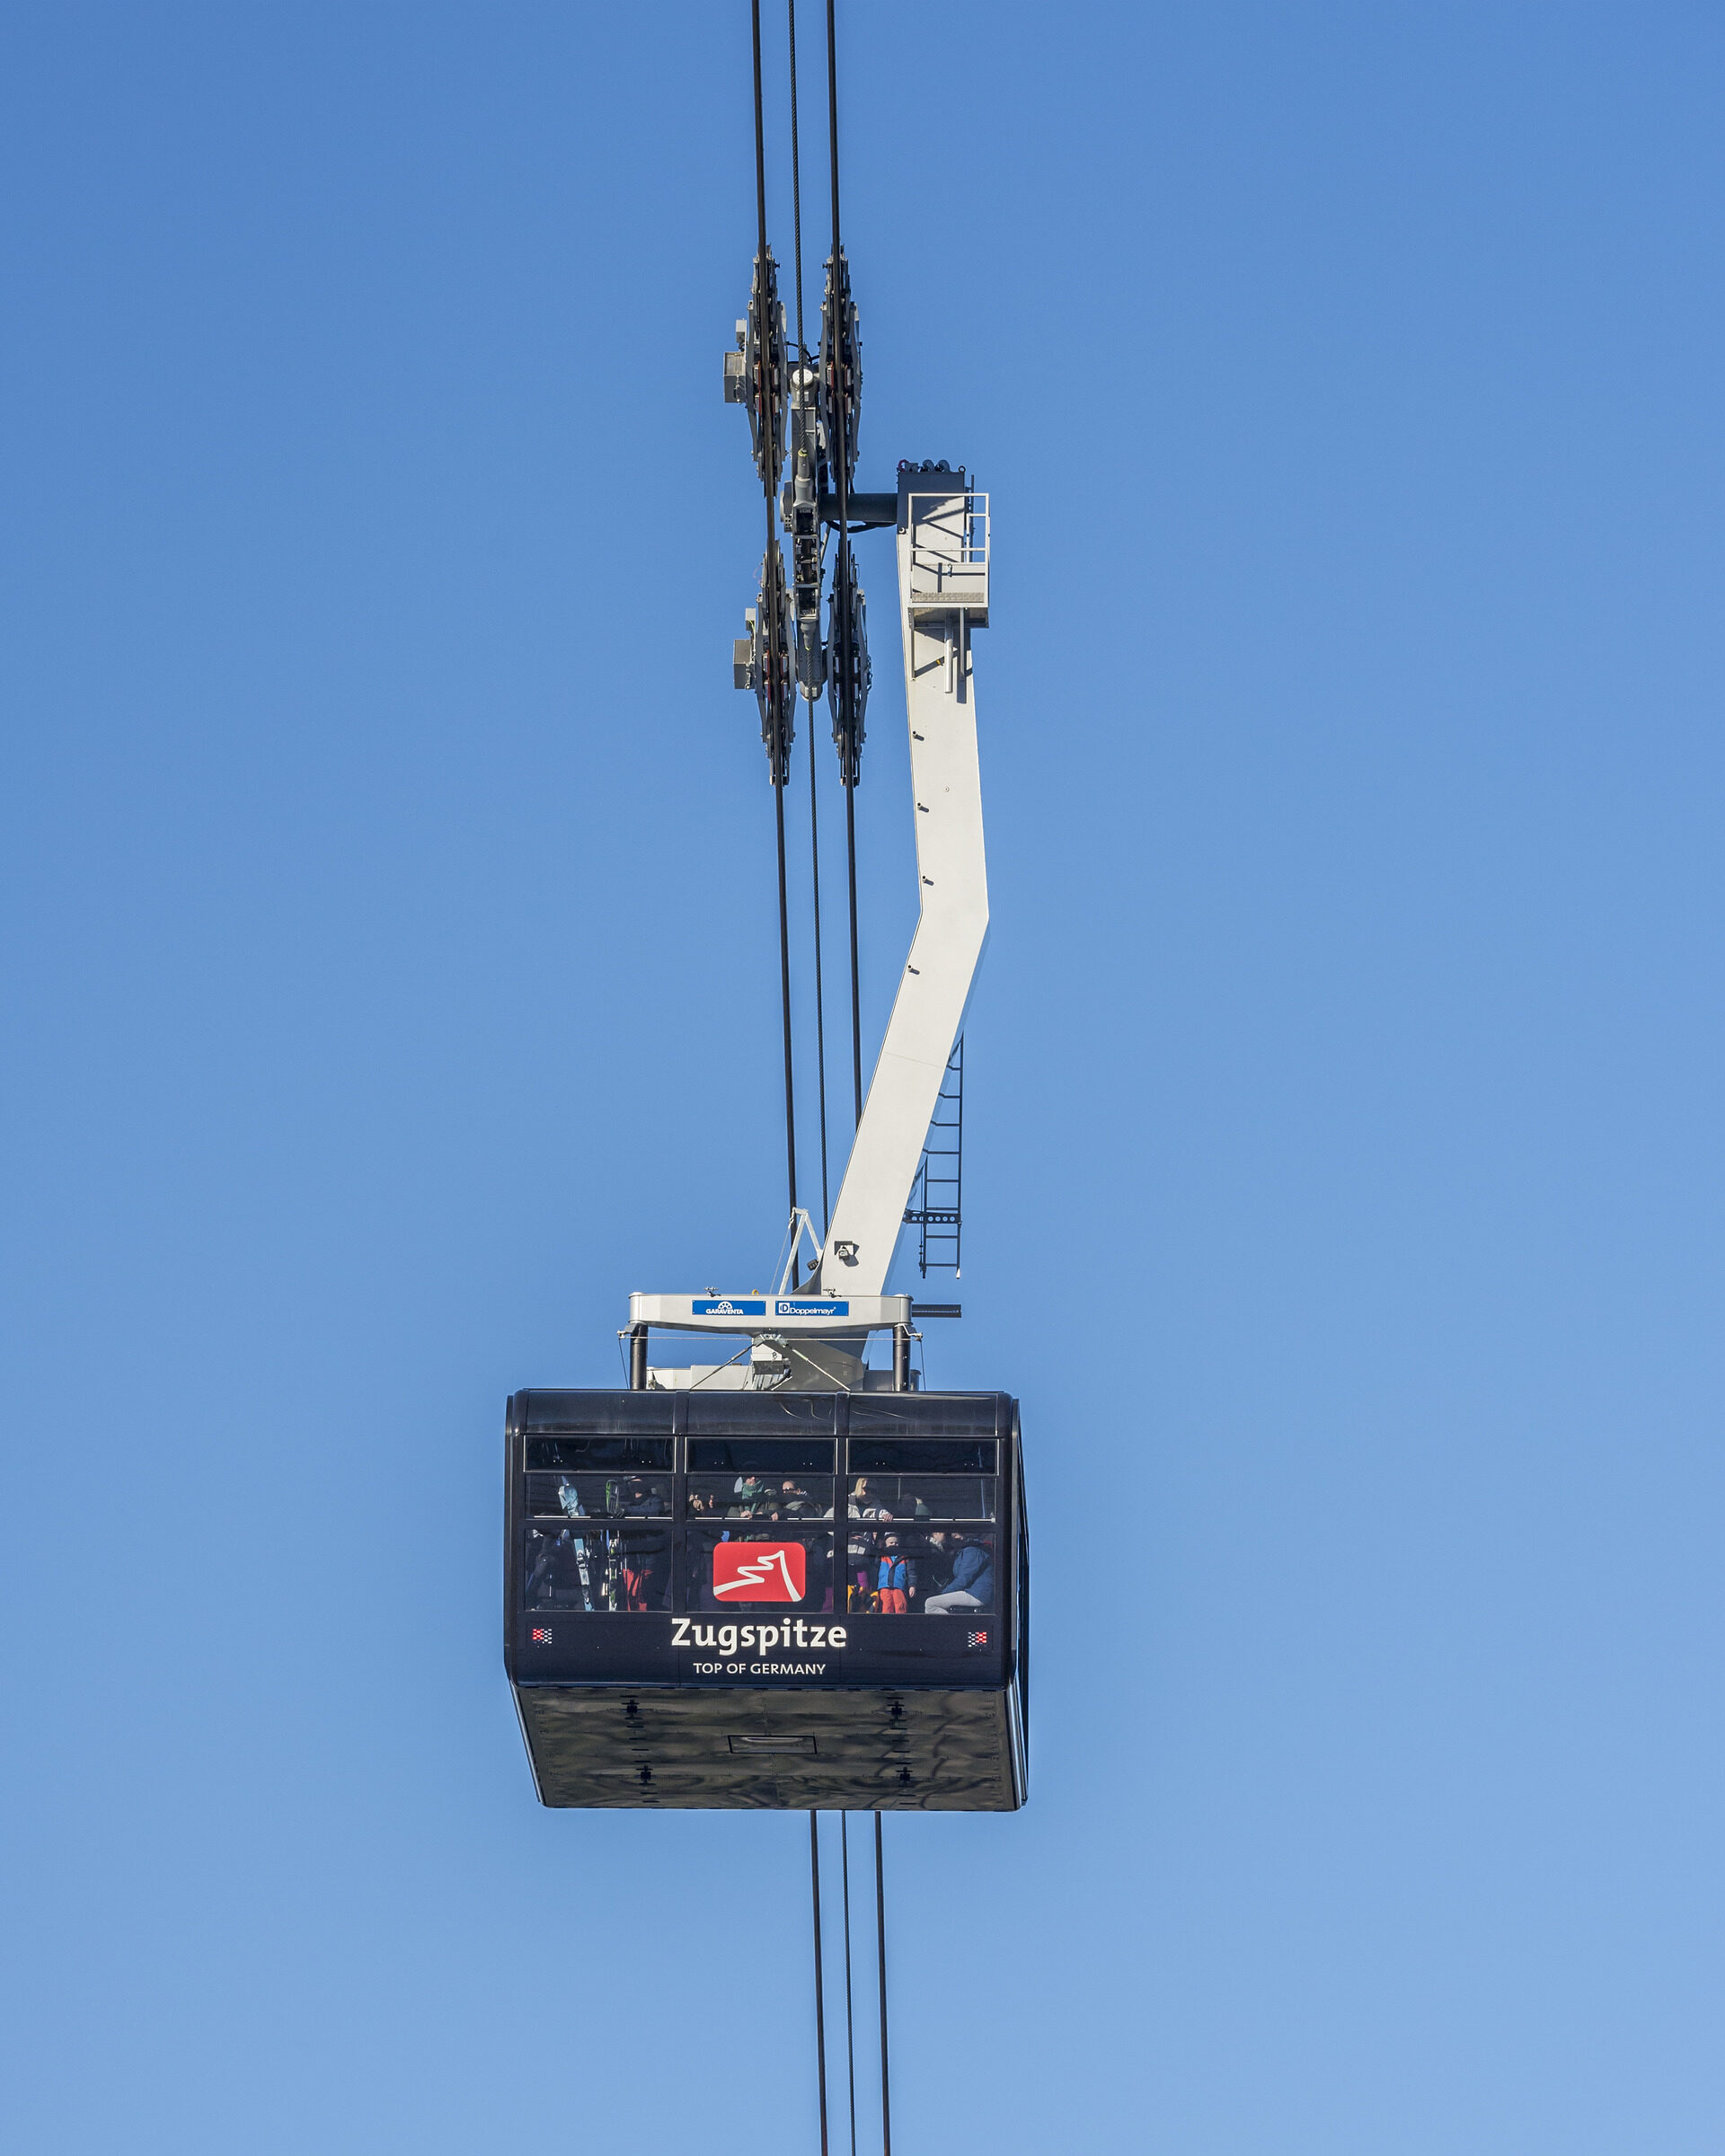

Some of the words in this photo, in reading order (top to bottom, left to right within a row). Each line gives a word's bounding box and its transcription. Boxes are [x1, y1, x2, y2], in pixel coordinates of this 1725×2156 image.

[671, 1617, 847, 1657] Zugspitze
[693, 1663, 723, 1674] TOP
[726, 1662, 747, 1674] OF
[749, 1663, 827, 1674] GERMANY
